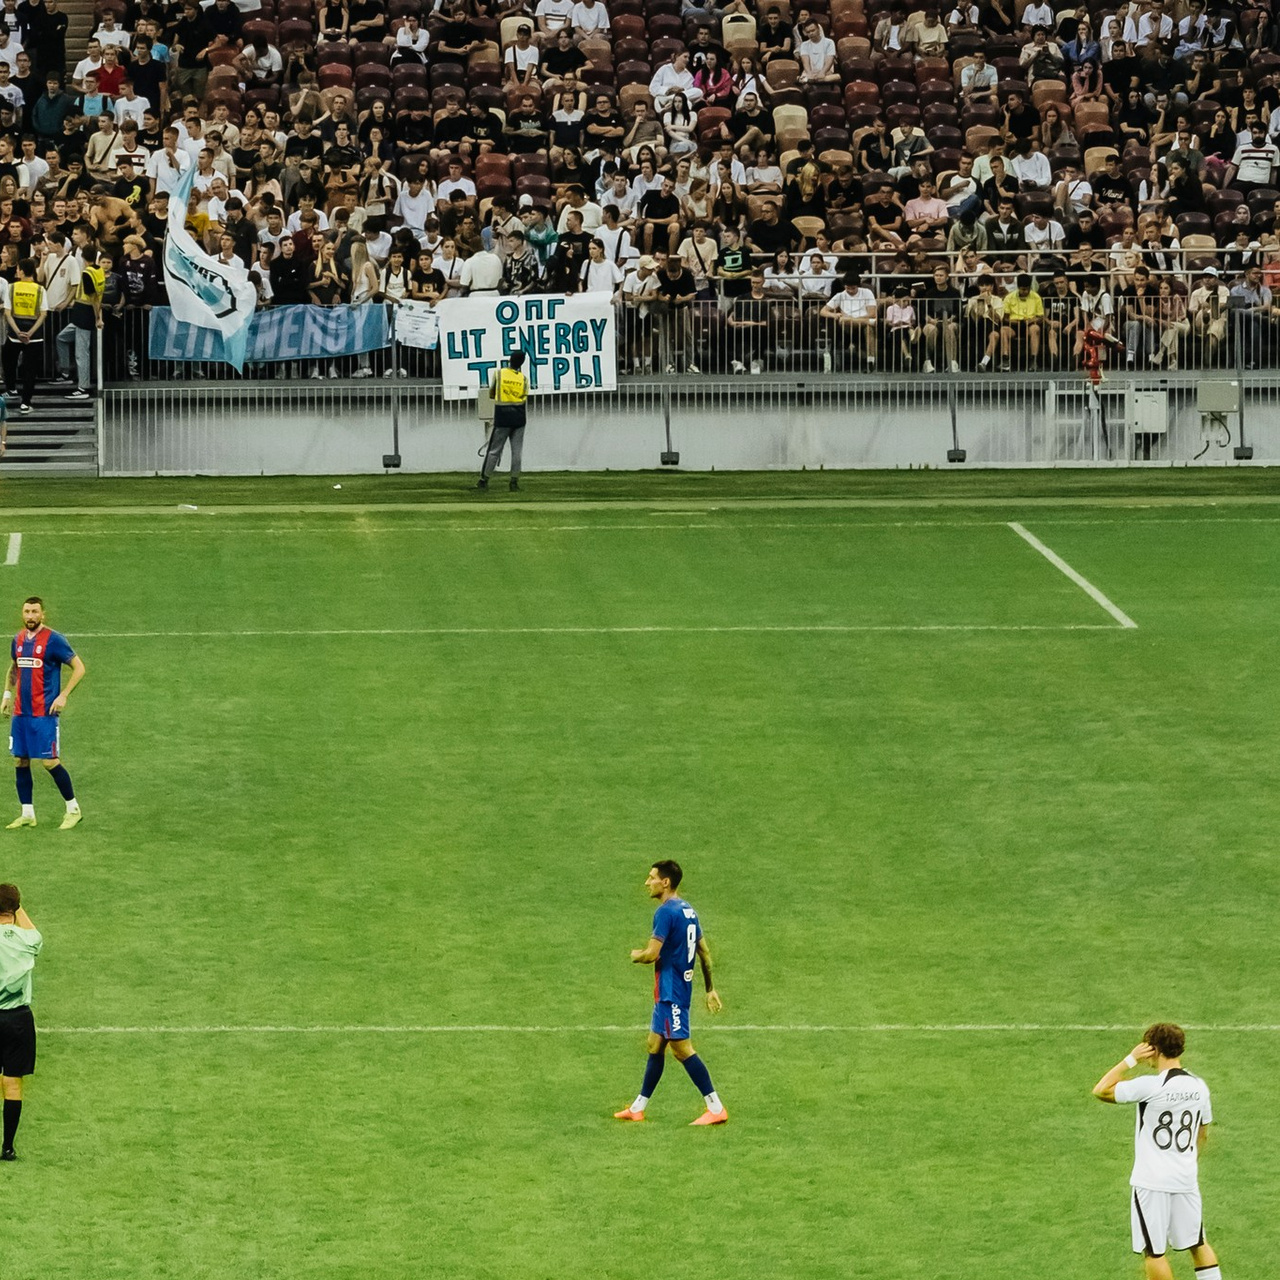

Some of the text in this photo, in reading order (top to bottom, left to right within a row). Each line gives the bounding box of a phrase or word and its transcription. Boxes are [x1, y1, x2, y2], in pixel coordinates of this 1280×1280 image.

[496, 299, 565, 325] ОПГ
[502, 318, 607, 359] ENERGY
[467, 355, 603, 390] ТГРЫ
